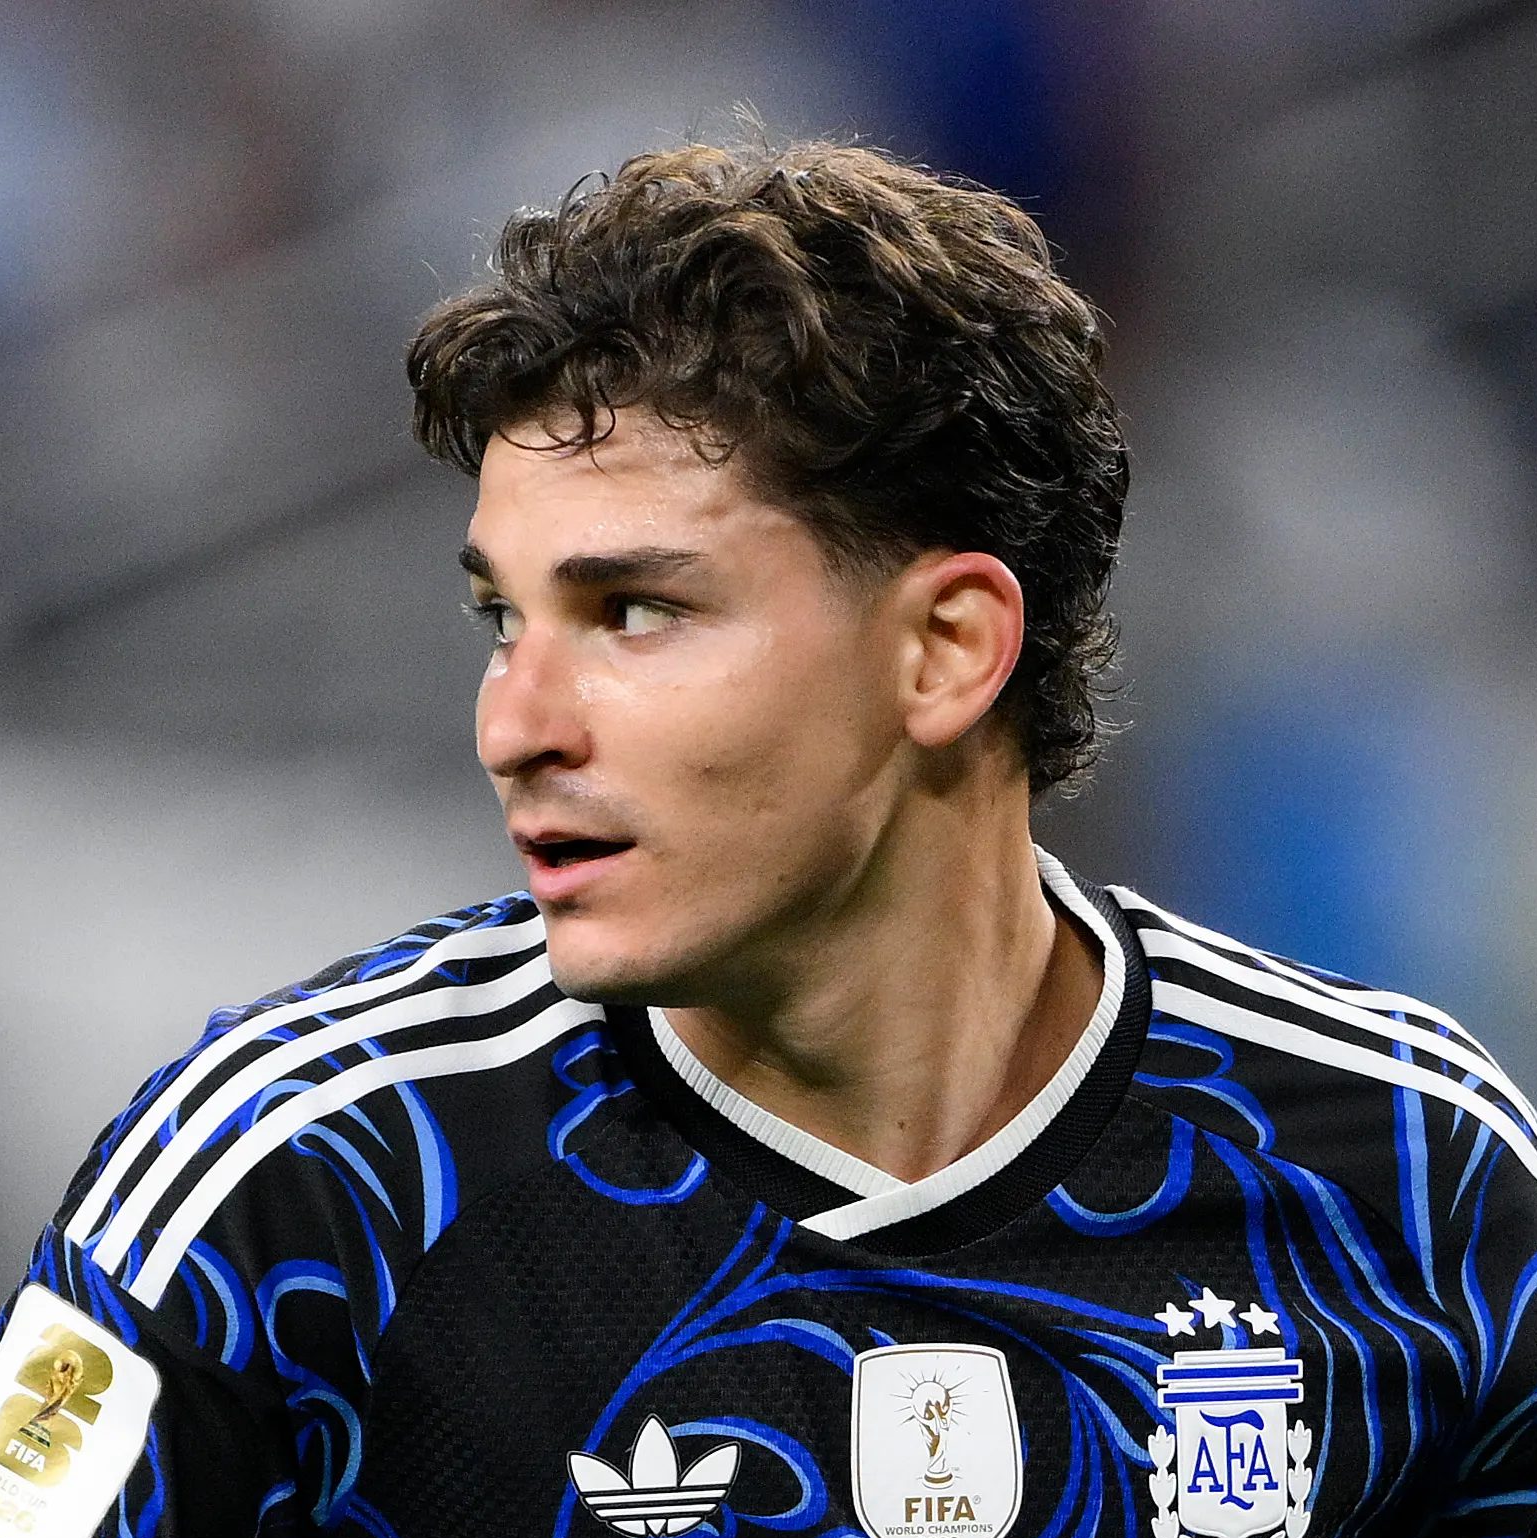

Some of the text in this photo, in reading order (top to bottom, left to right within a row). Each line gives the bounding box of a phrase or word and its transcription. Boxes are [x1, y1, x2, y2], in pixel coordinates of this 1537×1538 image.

[4, 1438, 47, 1473] FIFA
[1187, 1409, 1279, 1510] AFA
[21, 1491, 48, 1510] CUP
[905, 1496, 976, 1523] FIFA
[885, 1523, 993, 1536] WORLD CHAMPIONS
